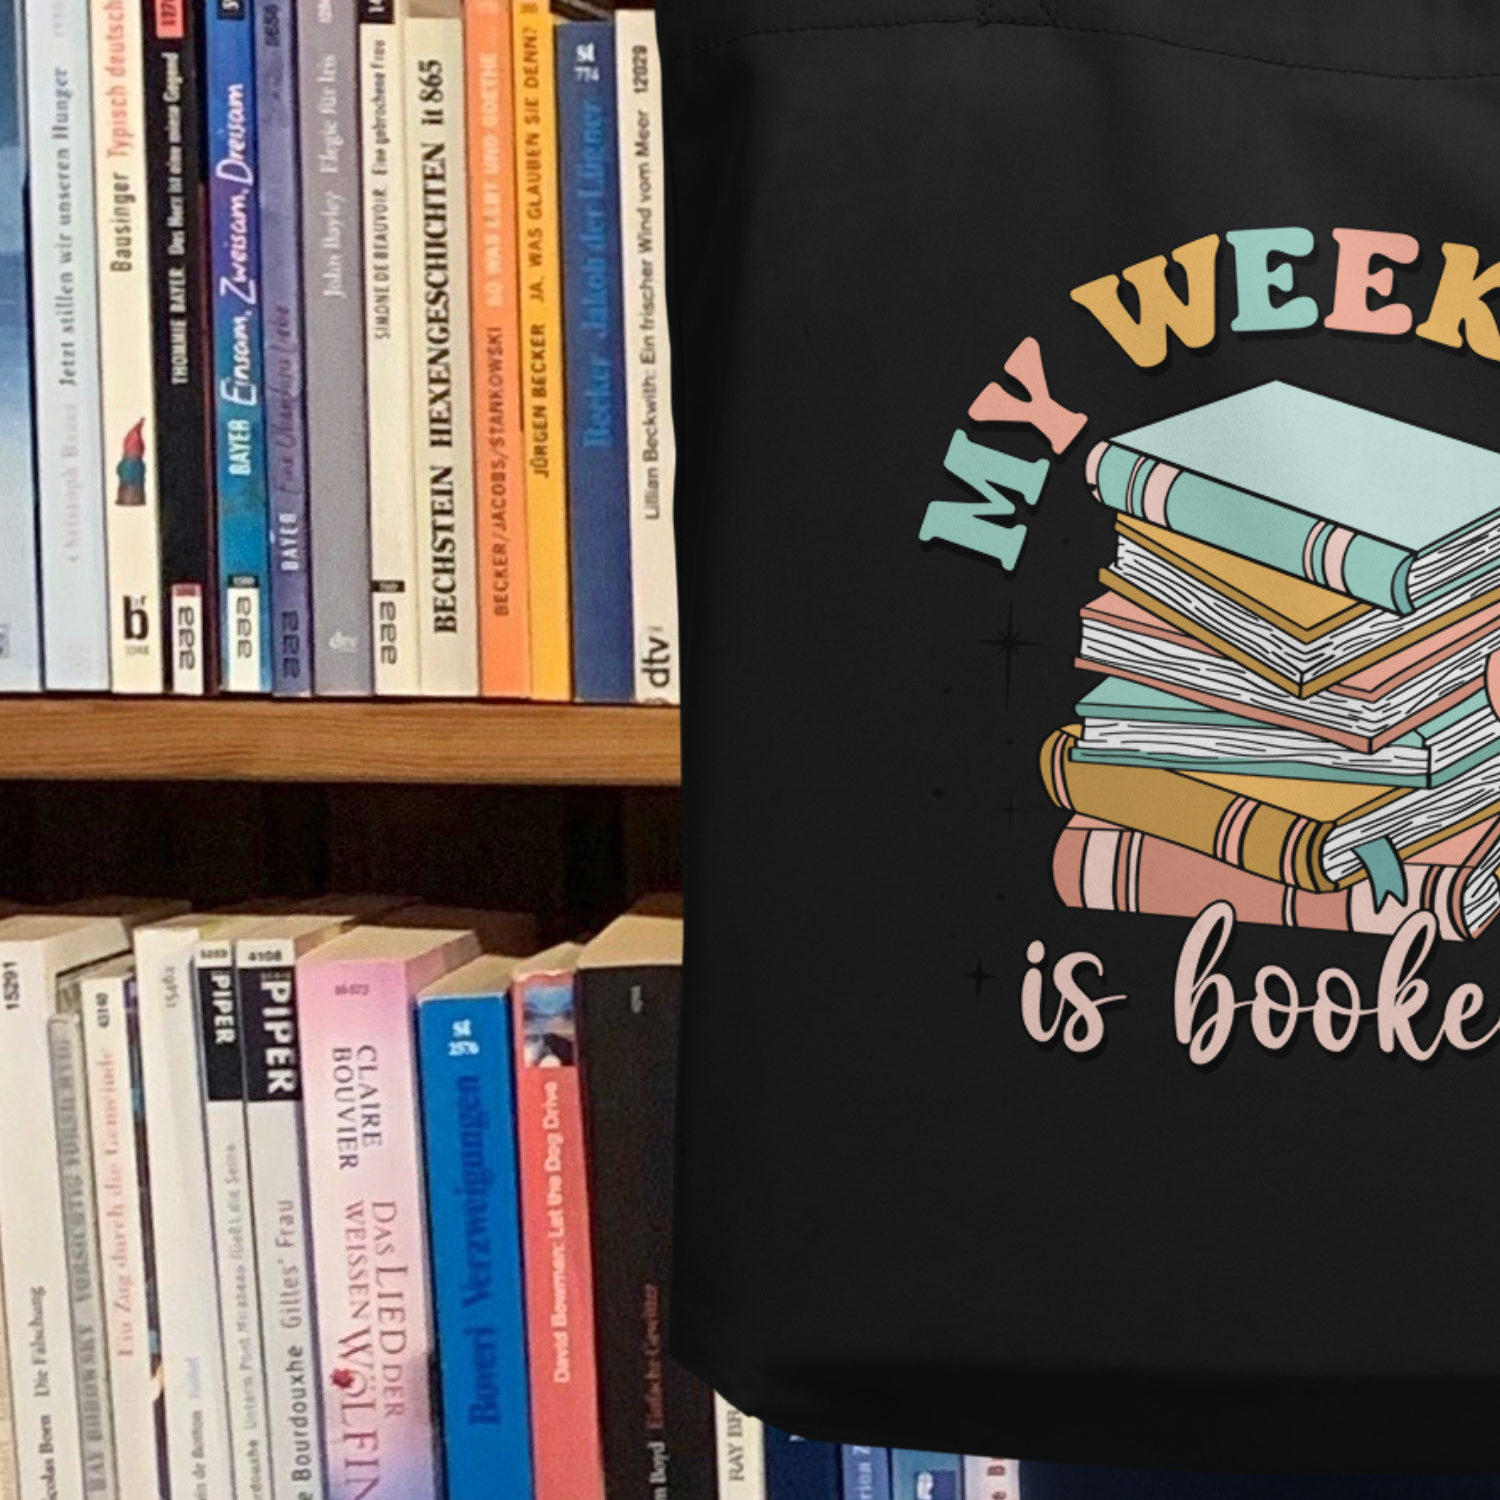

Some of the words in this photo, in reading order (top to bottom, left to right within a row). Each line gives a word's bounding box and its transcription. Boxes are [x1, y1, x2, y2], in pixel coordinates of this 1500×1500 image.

[103, 0, 126, 77] deutsch
[523, 27, 539, 88] DENN?
[52, 68, 72, 139] Hunger
[419, 60, 442, 102] 865
[525, 98, 540, 124] SIE
[106, 85, 134, 157] Typisch
[216, 84, 253, 185] Dreisam
[422, 110, 442, 124] it
[635, 110, 649, 157] Meer
[57, 148, 71, 225] unseren
[525, 133, 542, 219] GLAUBEN
[636, 164, 653, 202] vom
[58, 234, 72, 263] wir
[110, 173, 136, 272] Bausinger
[528, 228, 542, 266] WAS
[637, 208, 652, 253] Wind
[55, 272, 74, 333] stillen
[423, 144, 452, 447] HEXENGESCHICHTEN
[640, 260, 654, 330] frischer
[59, 342, 76, 385] Jetzt
[531, 325, 546, 397] BECKER
[640, 336, 655, 364] Ein
[228, 420, 250, 474] BAYER
[530, 406, 549, 478] JÜRGEN
[640, 372, 659, 461] Beckwith:
[487, 327, 509, 616] BECKER/JACOBS/STANKOWSKI
[918, 336, 1089, 571] MY
[645, 467, 660, 520] Lillian
[431, 467, 456, 632] BECHSTEIN
[642, 637, 670, 687] dtv
[214, 973, 234, 1045] PIPER
[1020, 940, 1127, 1052] is
[260, 979, 294, 1091] PIPER
[333, 1048, 358, 1169] BOUVIER
[357, 1044, 382, 1145] CLAIRE
[275, 1201, 294, 1247] Frau
[346, 1201, 369, 1318] WEISSEN
[376, 1202, 395, 1252] DAS
[28, 1286, 47, 1365] Fälschung
[380, 1263, 409, 1349] LIED
[35, 1371, 49, 1396] Die
[286, 1346, 312, 1481] Bourdouxhe
[382, 1364, 404, 1417] DER
[39, 1415, 53, 1453] Born
